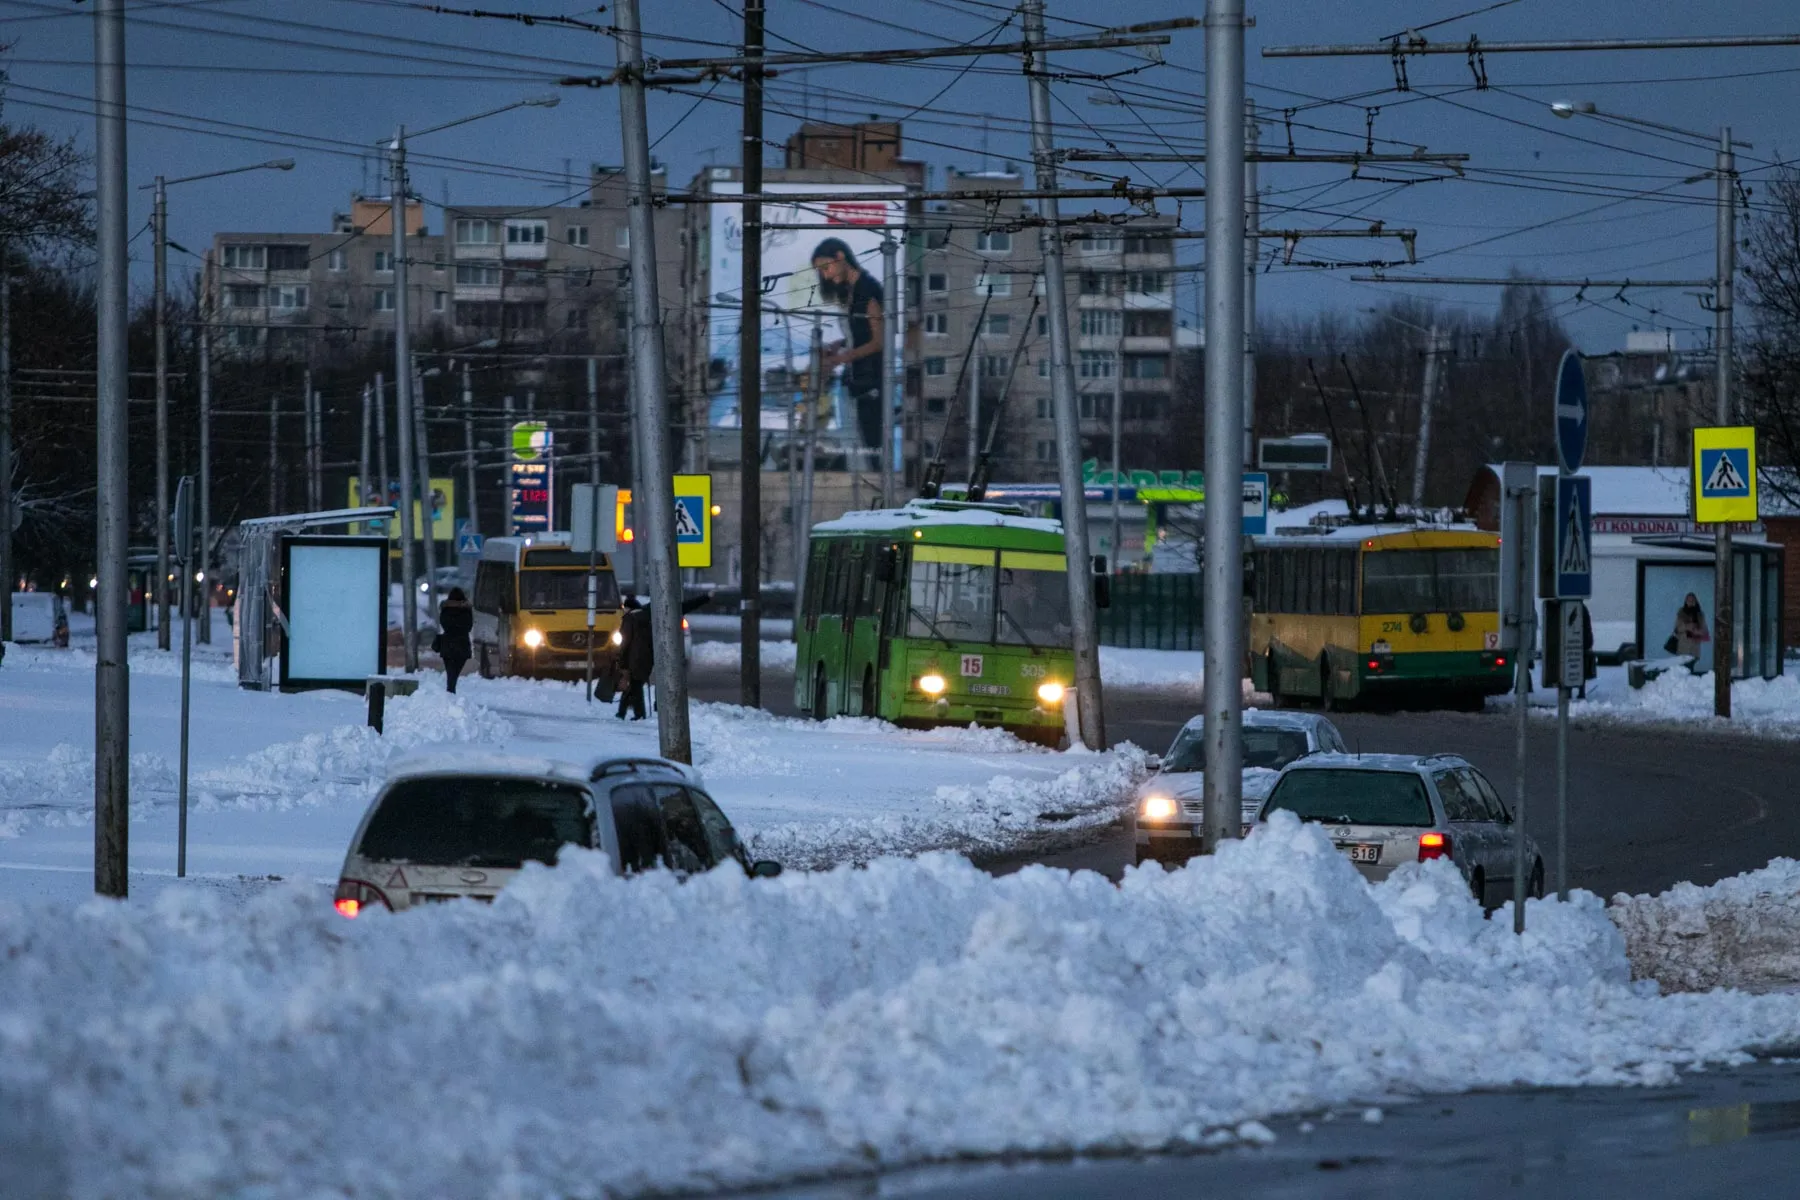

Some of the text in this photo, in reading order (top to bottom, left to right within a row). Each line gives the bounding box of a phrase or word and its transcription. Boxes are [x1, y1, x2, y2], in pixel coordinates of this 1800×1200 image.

[1382, 621, 1402, 633] 274
[1488, 633, 1498, 649] 9
[963, 657, 981, 674] 15
[1351, 847, 1376, 860] 518
